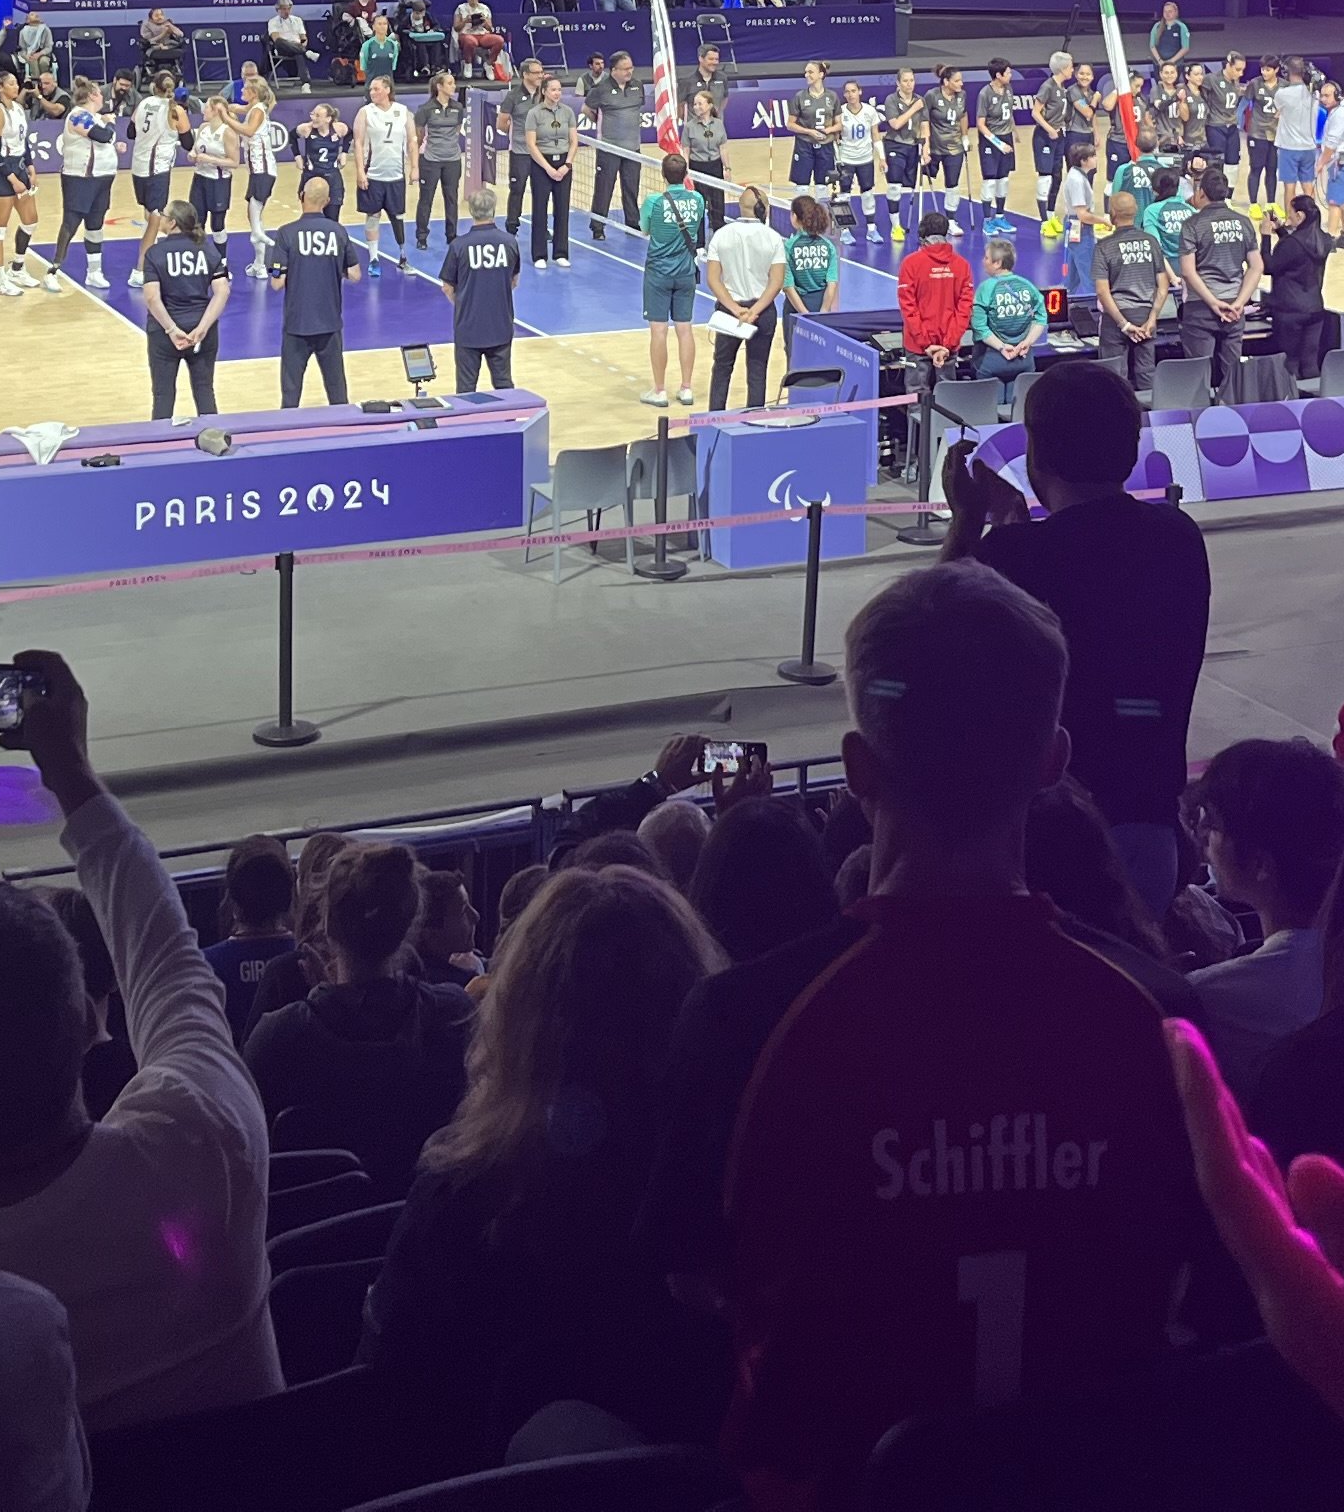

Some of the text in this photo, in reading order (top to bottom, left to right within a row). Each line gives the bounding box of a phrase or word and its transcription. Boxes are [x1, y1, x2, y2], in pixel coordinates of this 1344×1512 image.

[746, 18, 772, 26] PARIS
[831, 16, 856, 24] PARIS
[1225, 92, 1236, 109] 12
[816, 109, 825, 123] 5
[1001, 104, 1010, 121] 6
[141, 112, 151, 133] 5
[384, 121, 394, 138] 7
[851, 123, 866, 140] 18
[318, 147, 329, 162] 2
[663, 198, 699, 211] PARIS
[1210, 219, 1243, 233] PARIS
[298, 231, 339, 257] USA
[1213, 231, 1244, 244] 2024
[794, 245, 829, 259] PARIS
[1119, 239, 1152, 254] PARIS
[167, 250, 210, 277] USA
[468, 243, 509, 270] USA
[794, 256, 828, 271] 2024
[1121, 251, 1154, 265] 2024
[996, 289, 1031, 306] PARIS
[1047, 290, 1061, 314] 0
[136, 478, 391, 531] PARIS 2024
[521, 537, 547, 546] PARIS
[369, 547, 423, 558] PARIS 2024
[109, 574, 167, 587] PARIS 2024
[871, 1110, 1110, 1203] Schiffler
[955, 1250, 1028, 1408] 1
